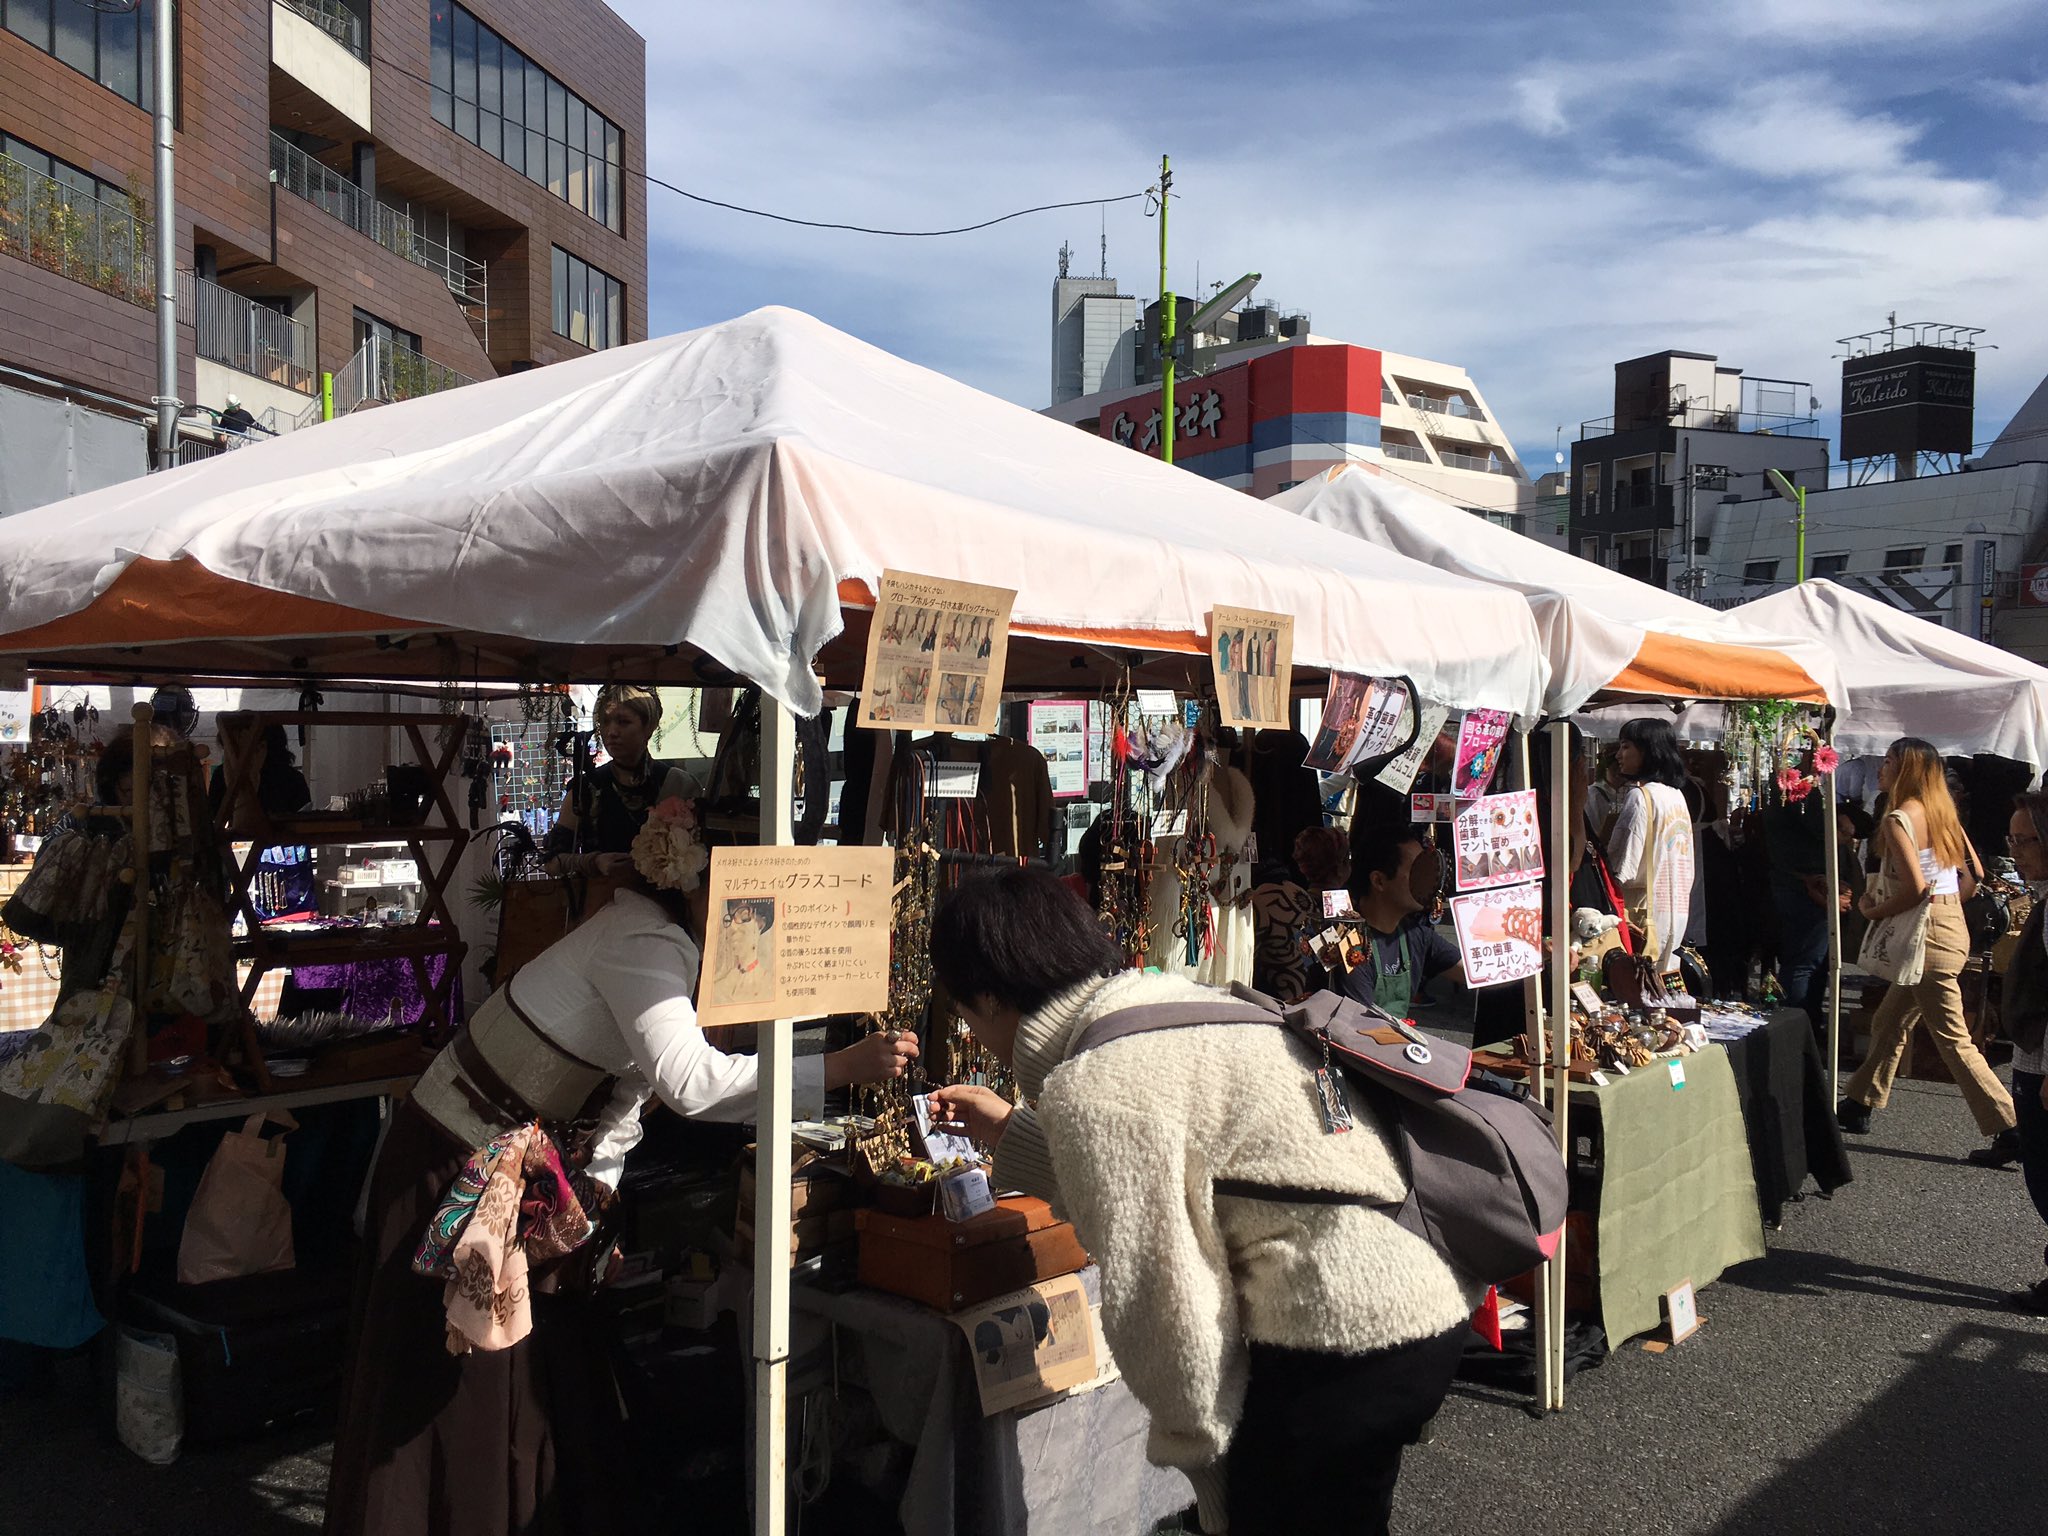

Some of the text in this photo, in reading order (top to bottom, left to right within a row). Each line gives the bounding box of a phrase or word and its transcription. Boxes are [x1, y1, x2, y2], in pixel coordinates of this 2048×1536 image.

[1891, 371, 1908, 380] SLOT
[1849, 380, 1908, 406] Kaleido
[1141, 389, 1222, 450] オゼキ
[1464, 735, 1493, 749] ブローチ
[1461, 836, 1509, 852] マント留め
[1470, 942, 1513, 959] 革の歯車
[1473, 951, 1530, 972] アームバンド
